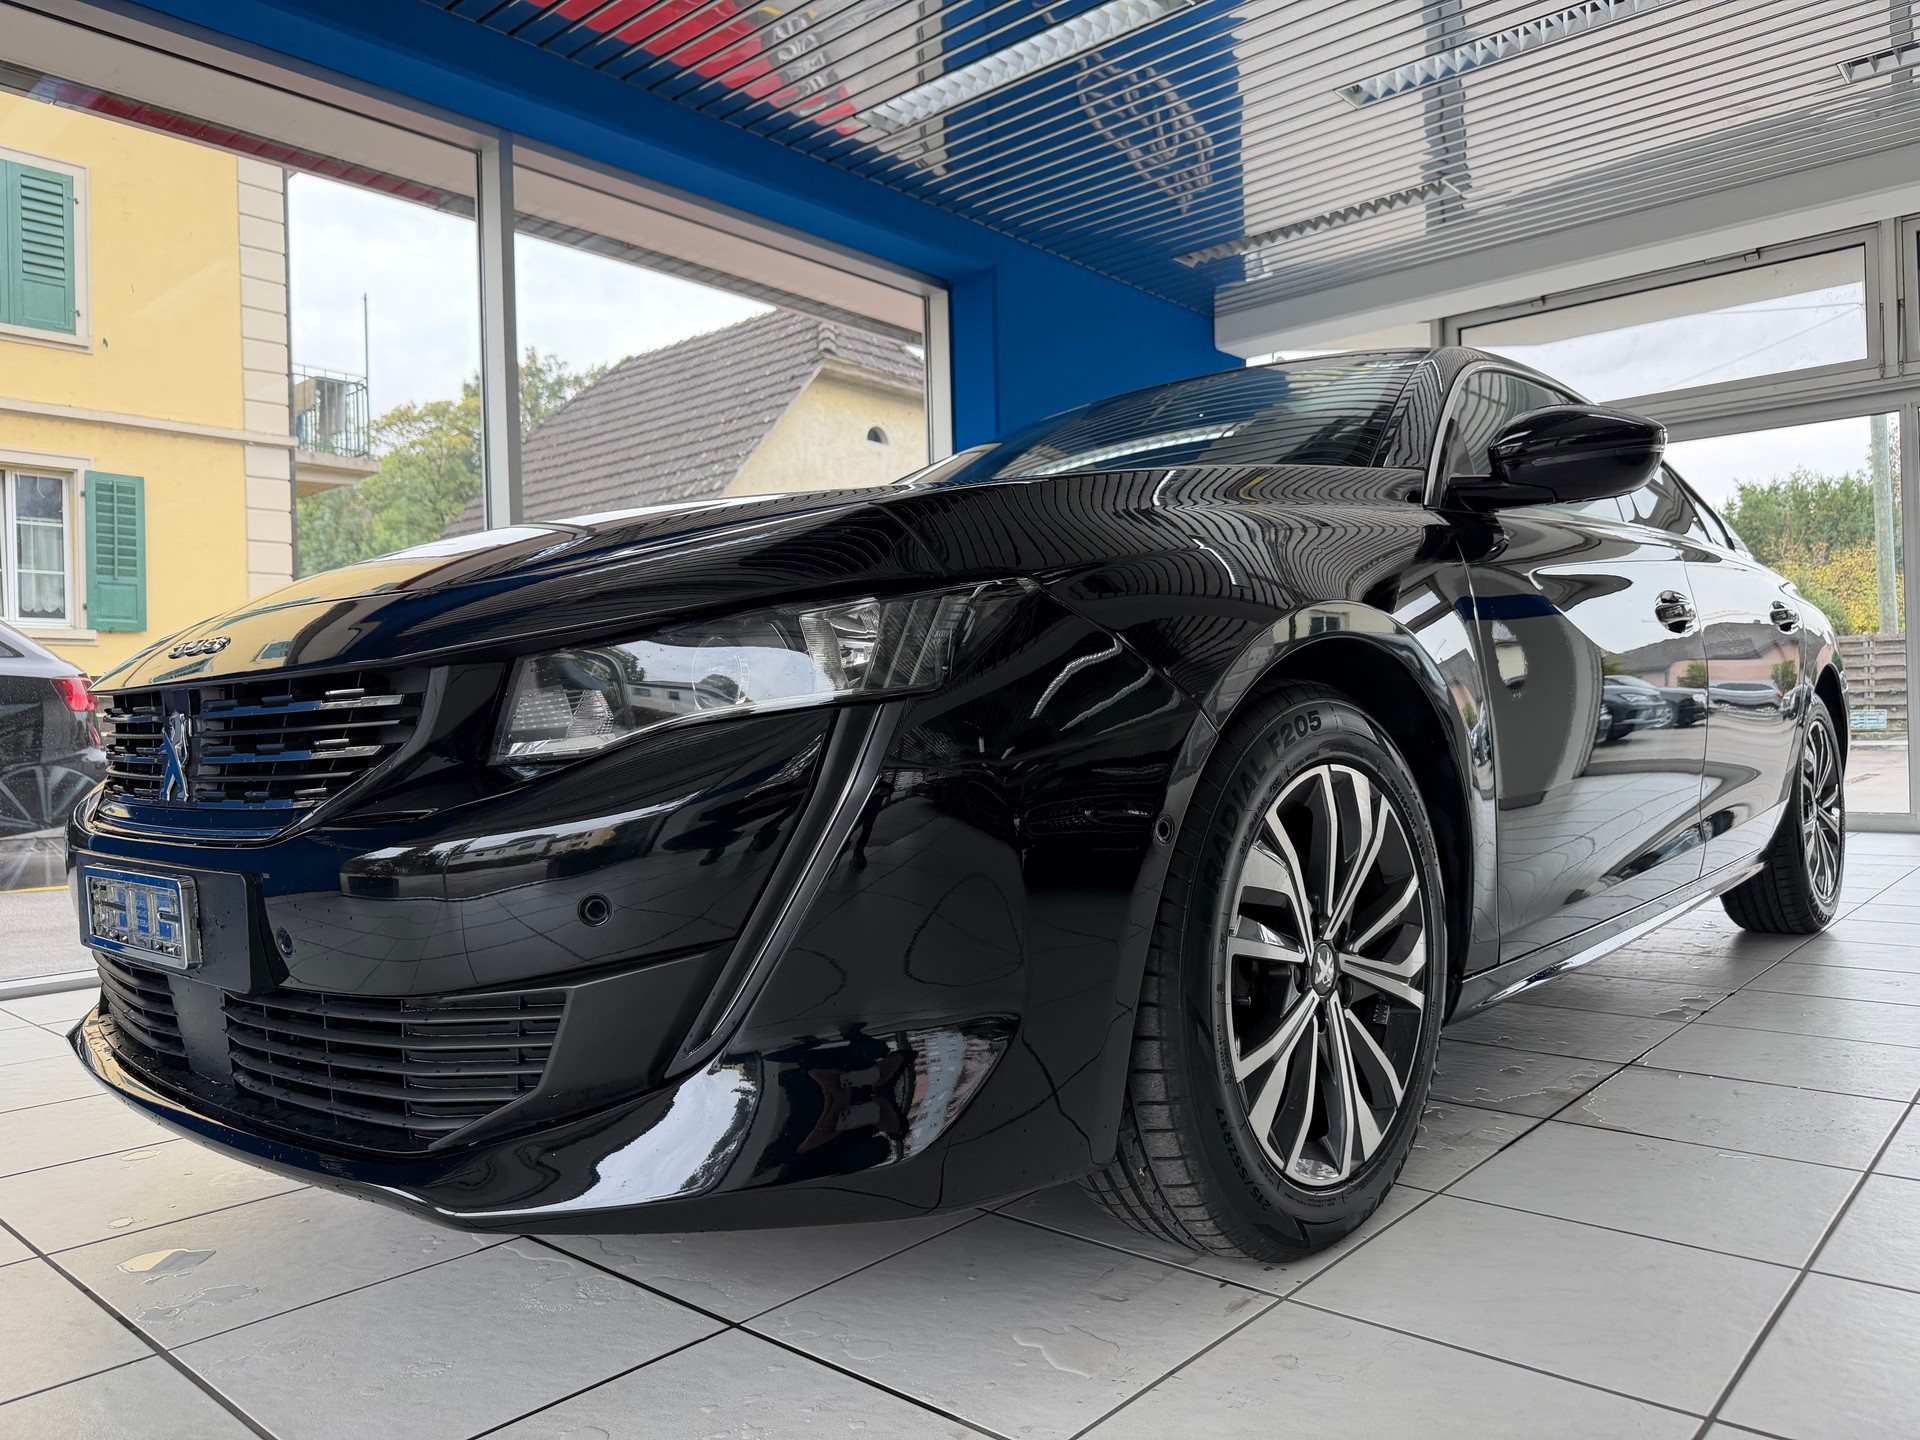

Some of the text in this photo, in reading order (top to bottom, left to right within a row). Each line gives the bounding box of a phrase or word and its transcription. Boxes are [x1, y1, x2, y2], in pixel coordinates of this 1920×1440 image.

[1203, 758, 1268, 894] RADIAL
[1267, 710, 1322, 758] F205
[1215, 1106, 1272, 1211] 215/55ZR17
